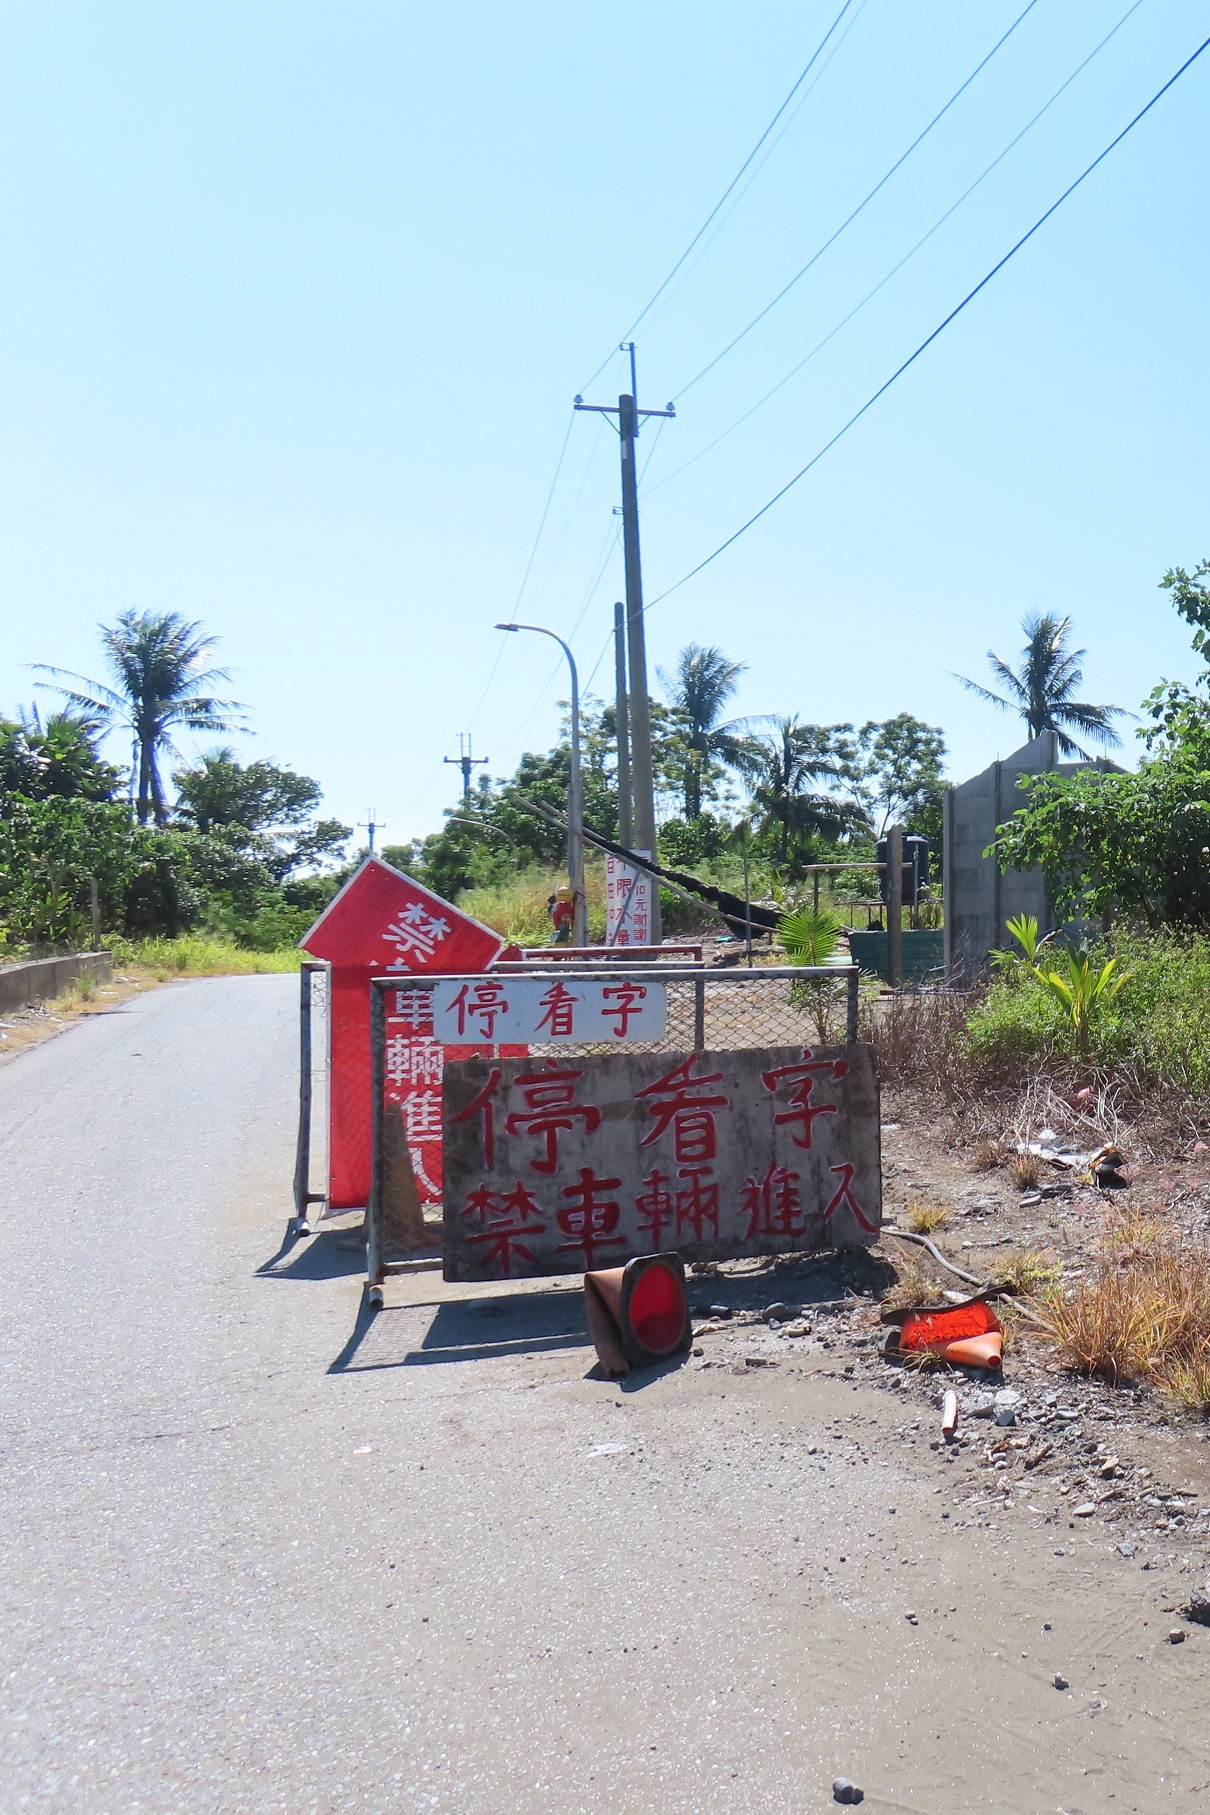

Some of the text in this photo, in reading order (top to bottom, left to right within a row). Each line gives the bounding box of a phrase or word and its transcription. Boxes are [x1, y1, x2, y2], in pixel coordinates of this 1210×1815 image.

[369, 901, 452, 972] 禁
[445, 982, 648, 1039] 停看字
[453, 1050, 849, 1175] 停看字
[462, 1159, 878, 1276] 禁車輛進入
